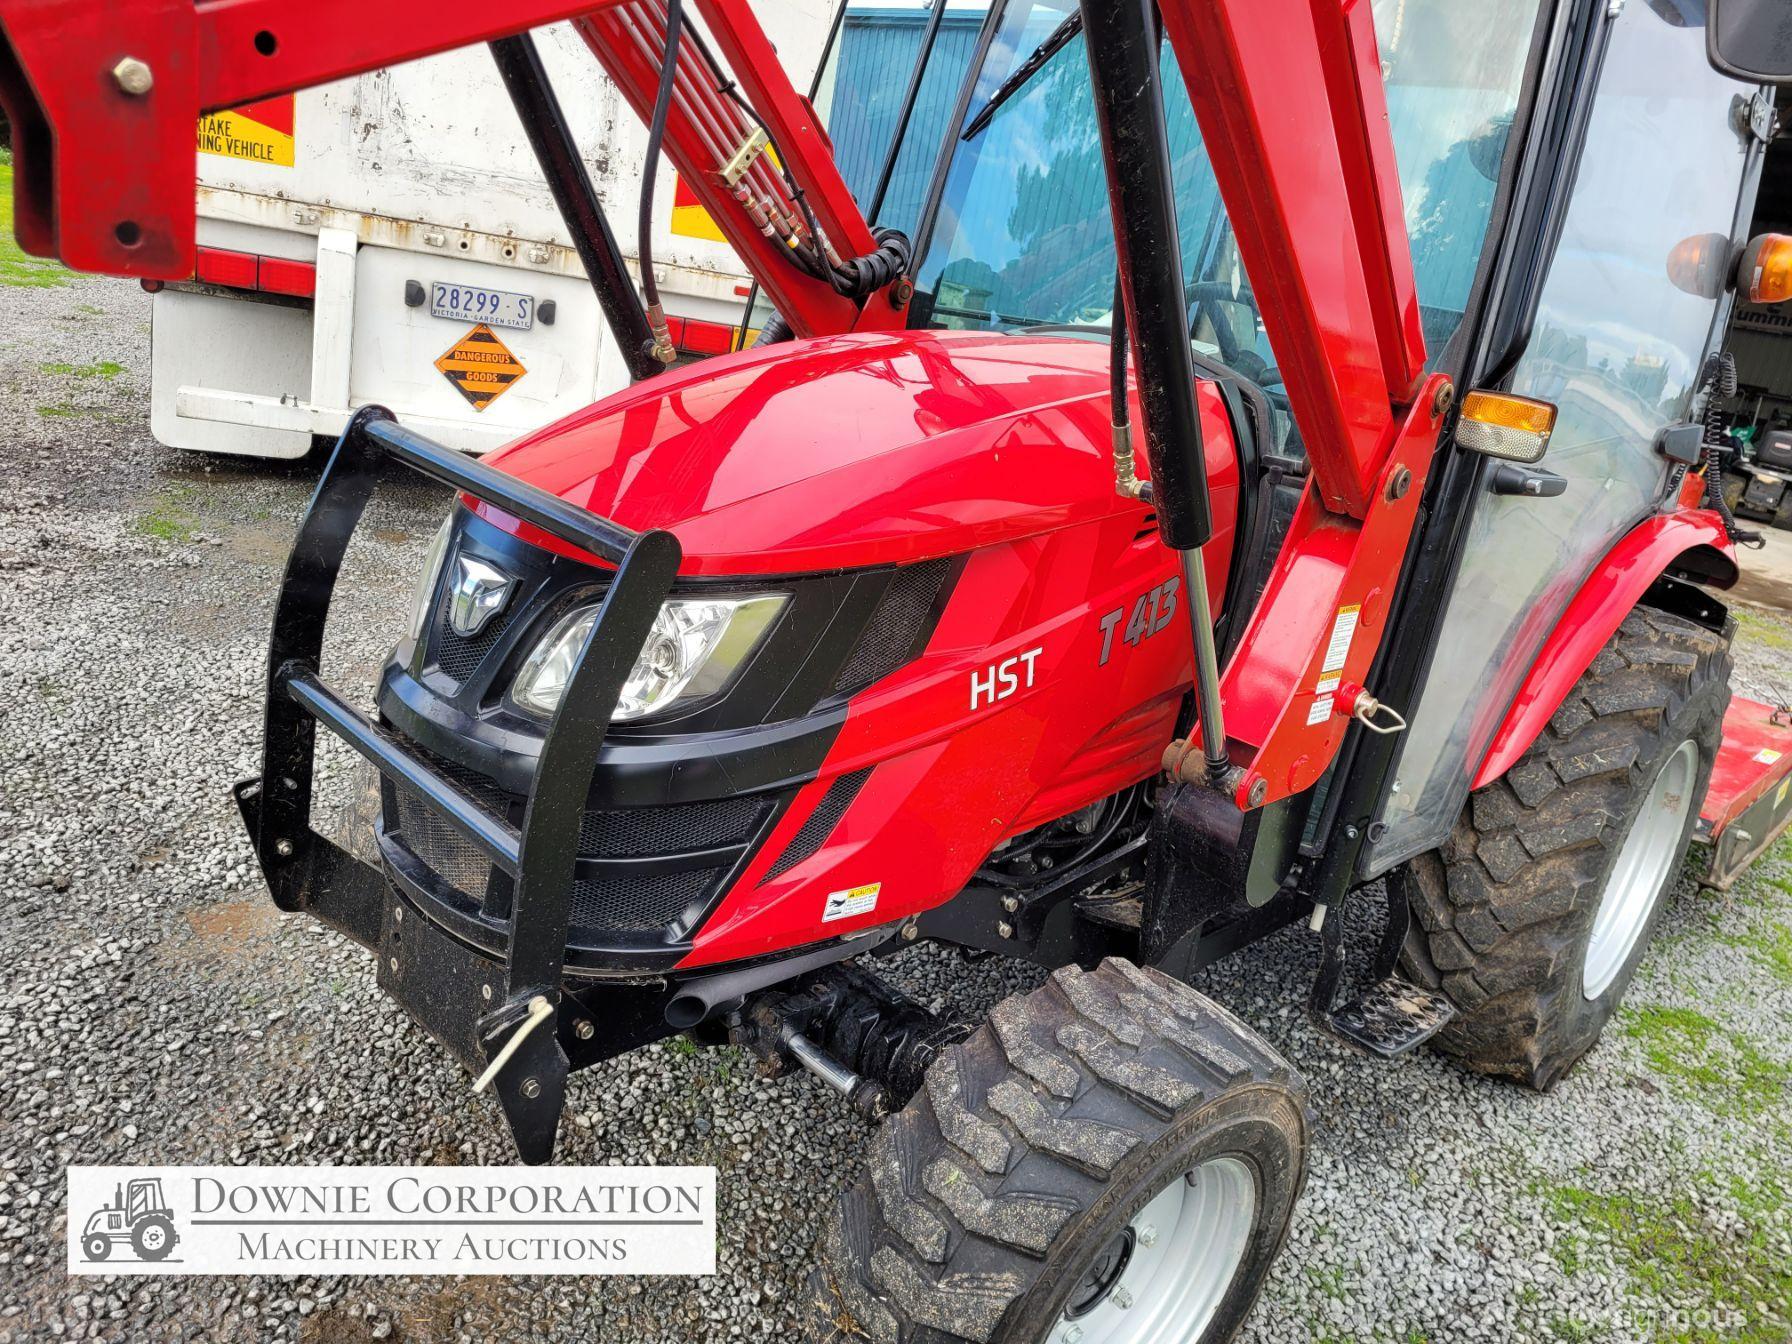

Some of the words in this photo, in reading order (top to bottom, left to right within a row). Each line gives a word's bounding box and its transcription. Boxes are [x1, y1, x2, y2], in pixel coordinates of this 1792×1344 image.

[226, 138, 274, 161] VEHICLE
[454, 351, 511, 364] DANGEROUS
[466, 371, 498, 382] GOODS
[1099, 607, 1123, 667] T
[1123, 576, 1180, 647] 413
[970, 647, 1043, 711] HST
